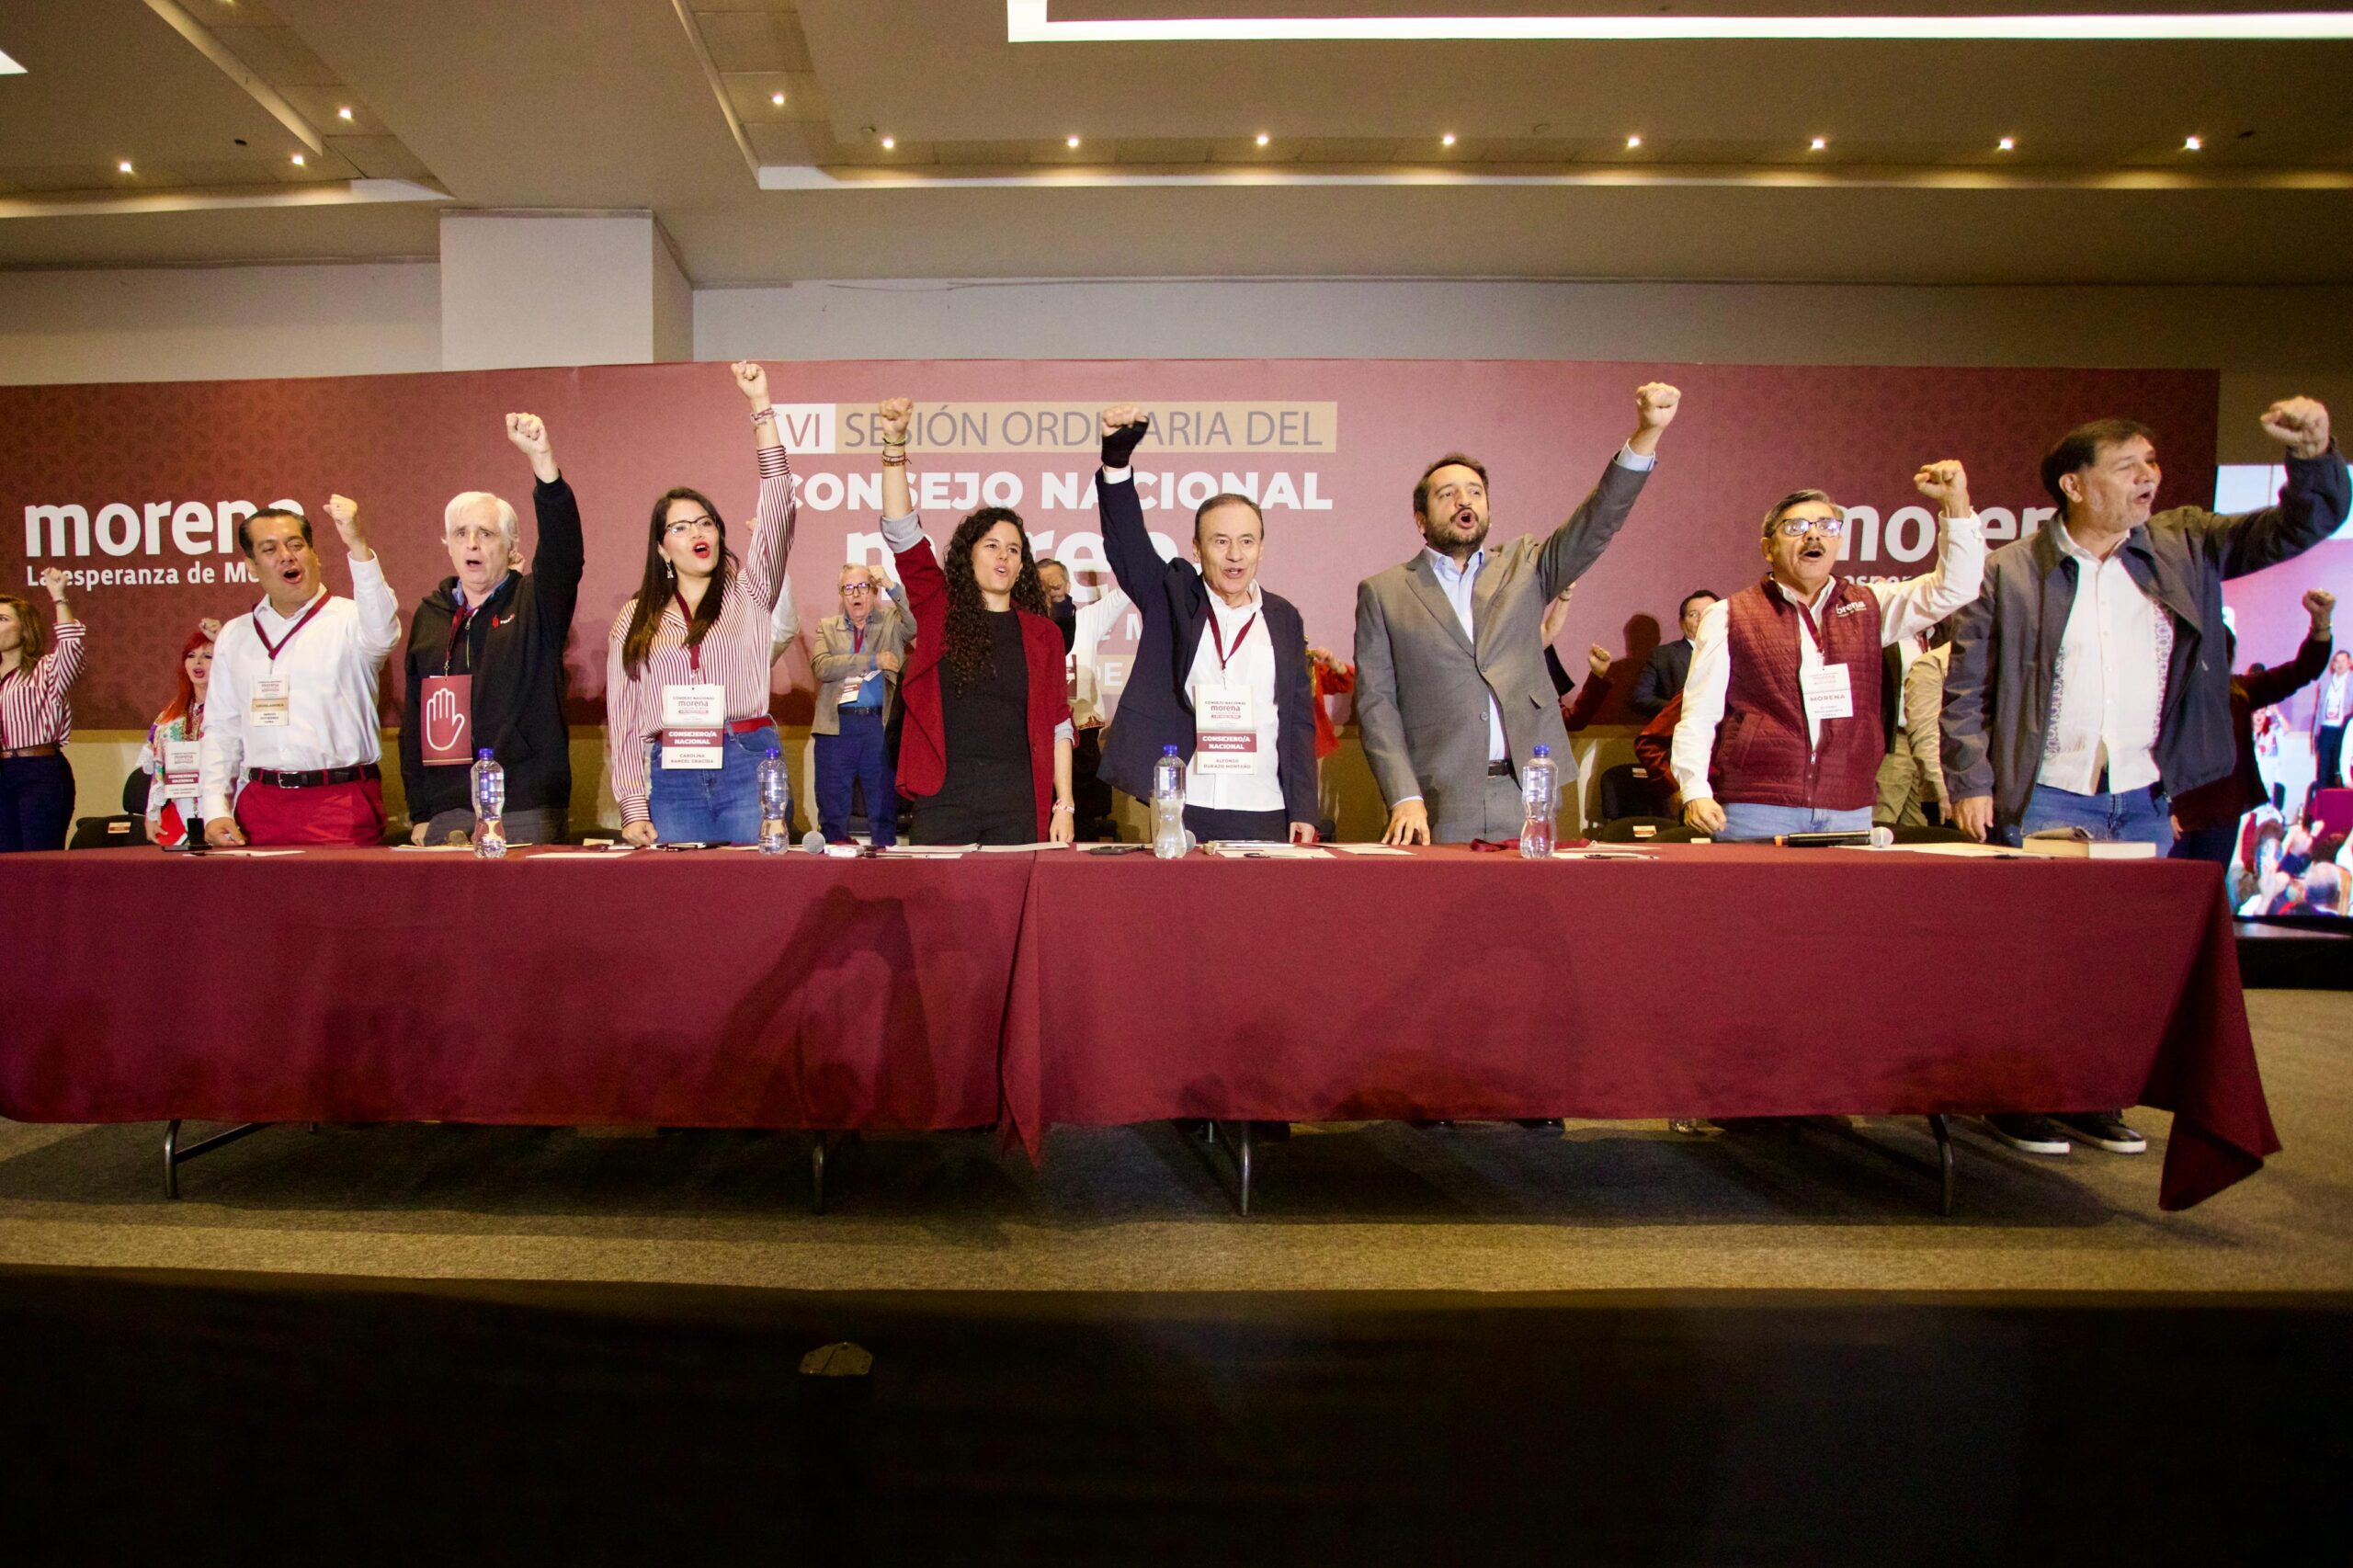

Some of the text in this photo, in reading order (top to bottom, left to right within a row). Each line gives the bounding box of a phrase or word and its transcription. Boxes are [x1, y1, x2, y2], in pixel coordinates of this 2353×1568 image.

[846, 404, 988, 448] SEIÓN
[1002, 411, 1233, 447] ORDIARIA
[1246, 411, 1323, 446] DEL
[188, 561, 215, 584] de
